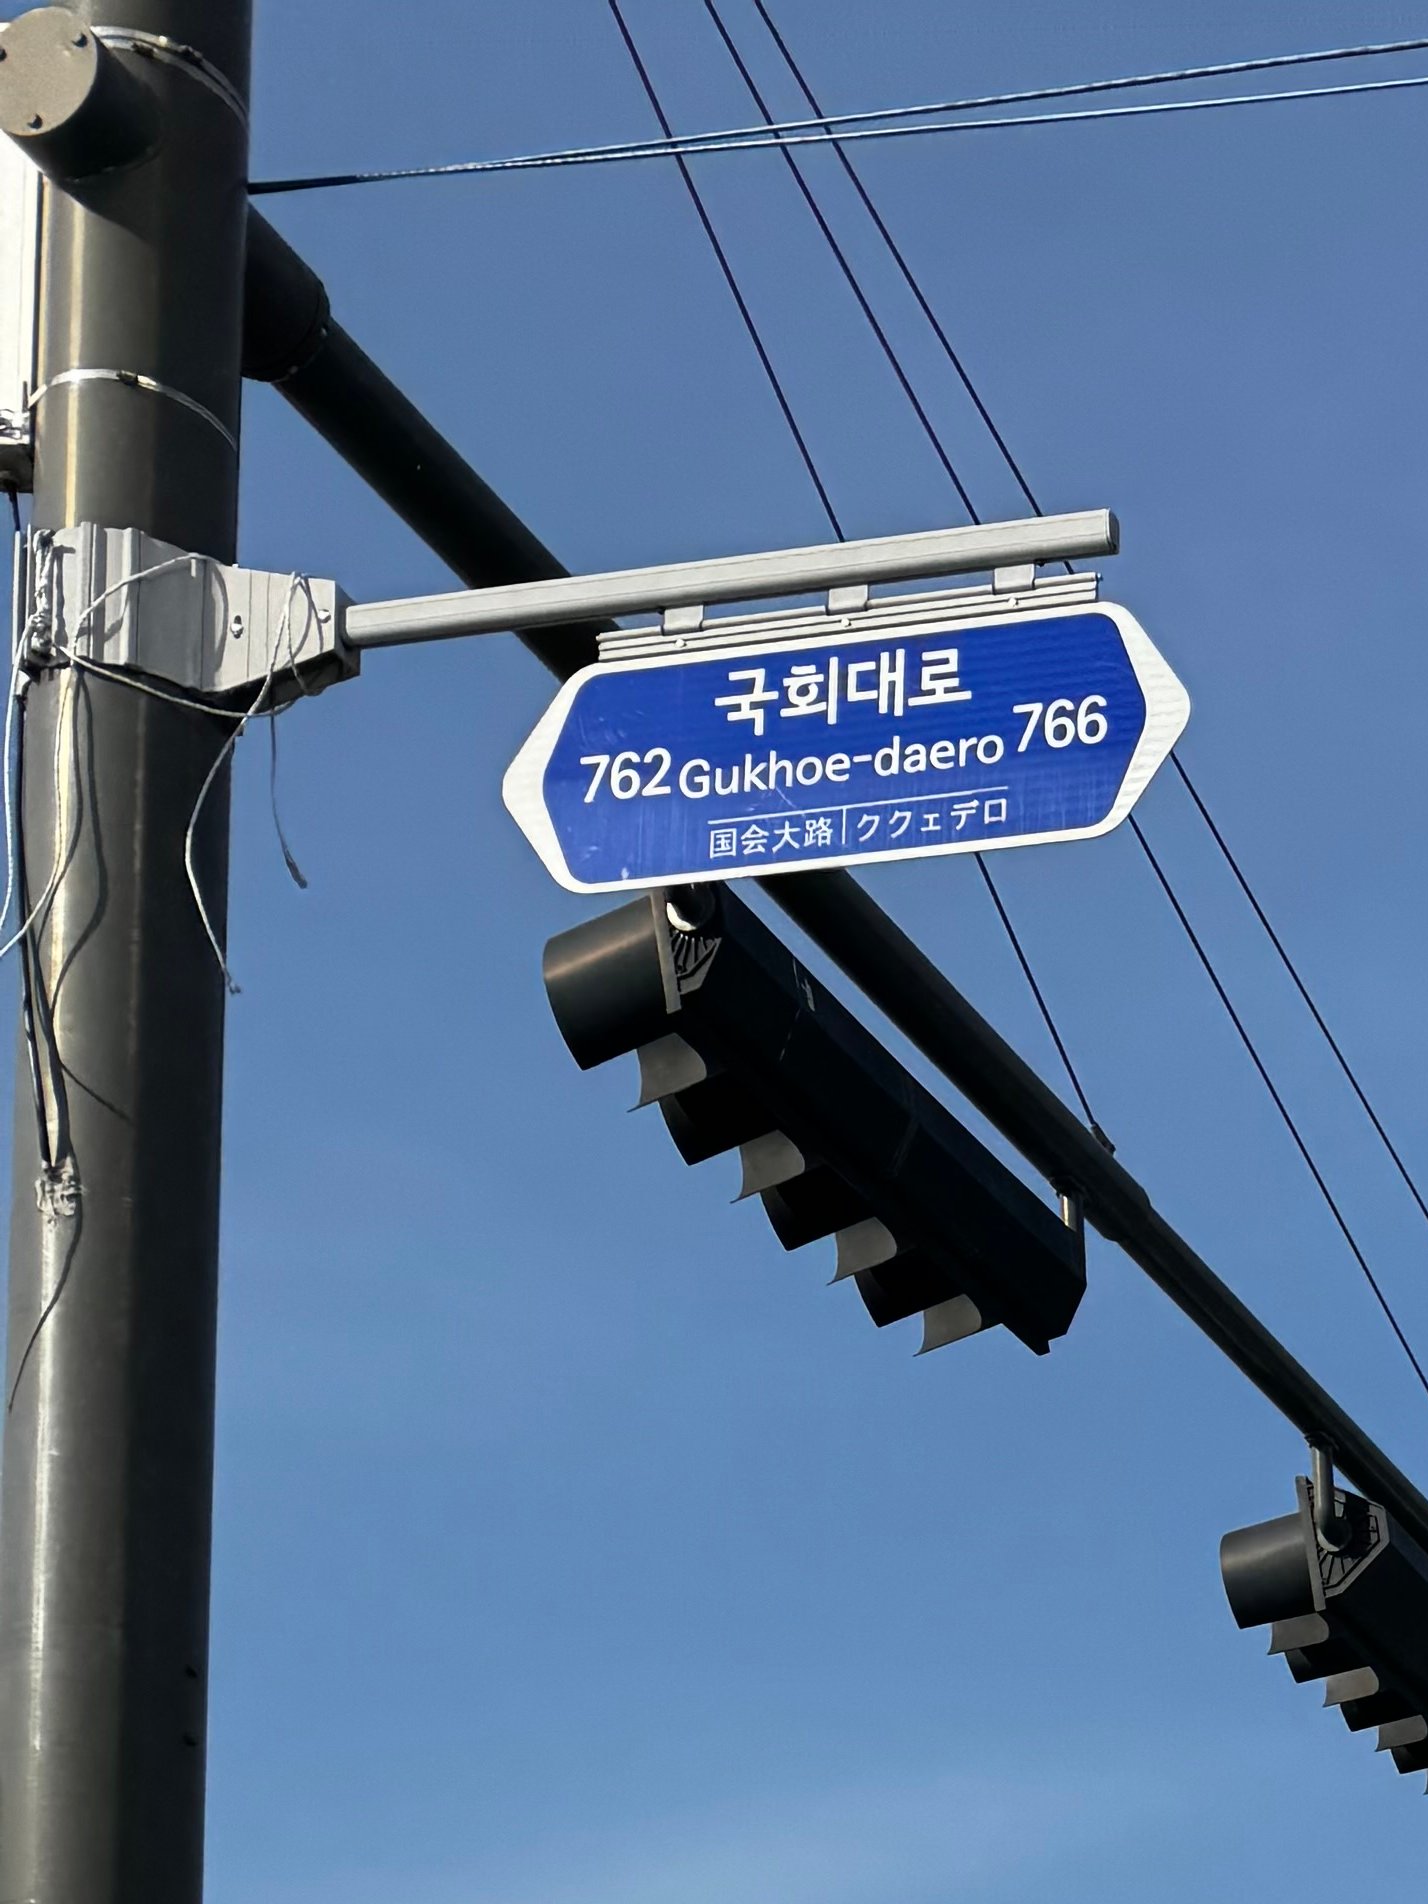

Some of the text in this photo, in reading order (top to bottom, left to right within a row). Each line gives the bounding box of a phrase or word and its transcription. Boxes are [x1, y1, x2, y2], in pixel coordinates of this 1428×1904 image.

[714, 647, 972, 736] 국회대로
[579, 695, 1109, 804] 762 Gukhoe-daero 766
[708, 817, 834, 859] 国会大路
[856, 797, 1007, 844] ククェデロ
